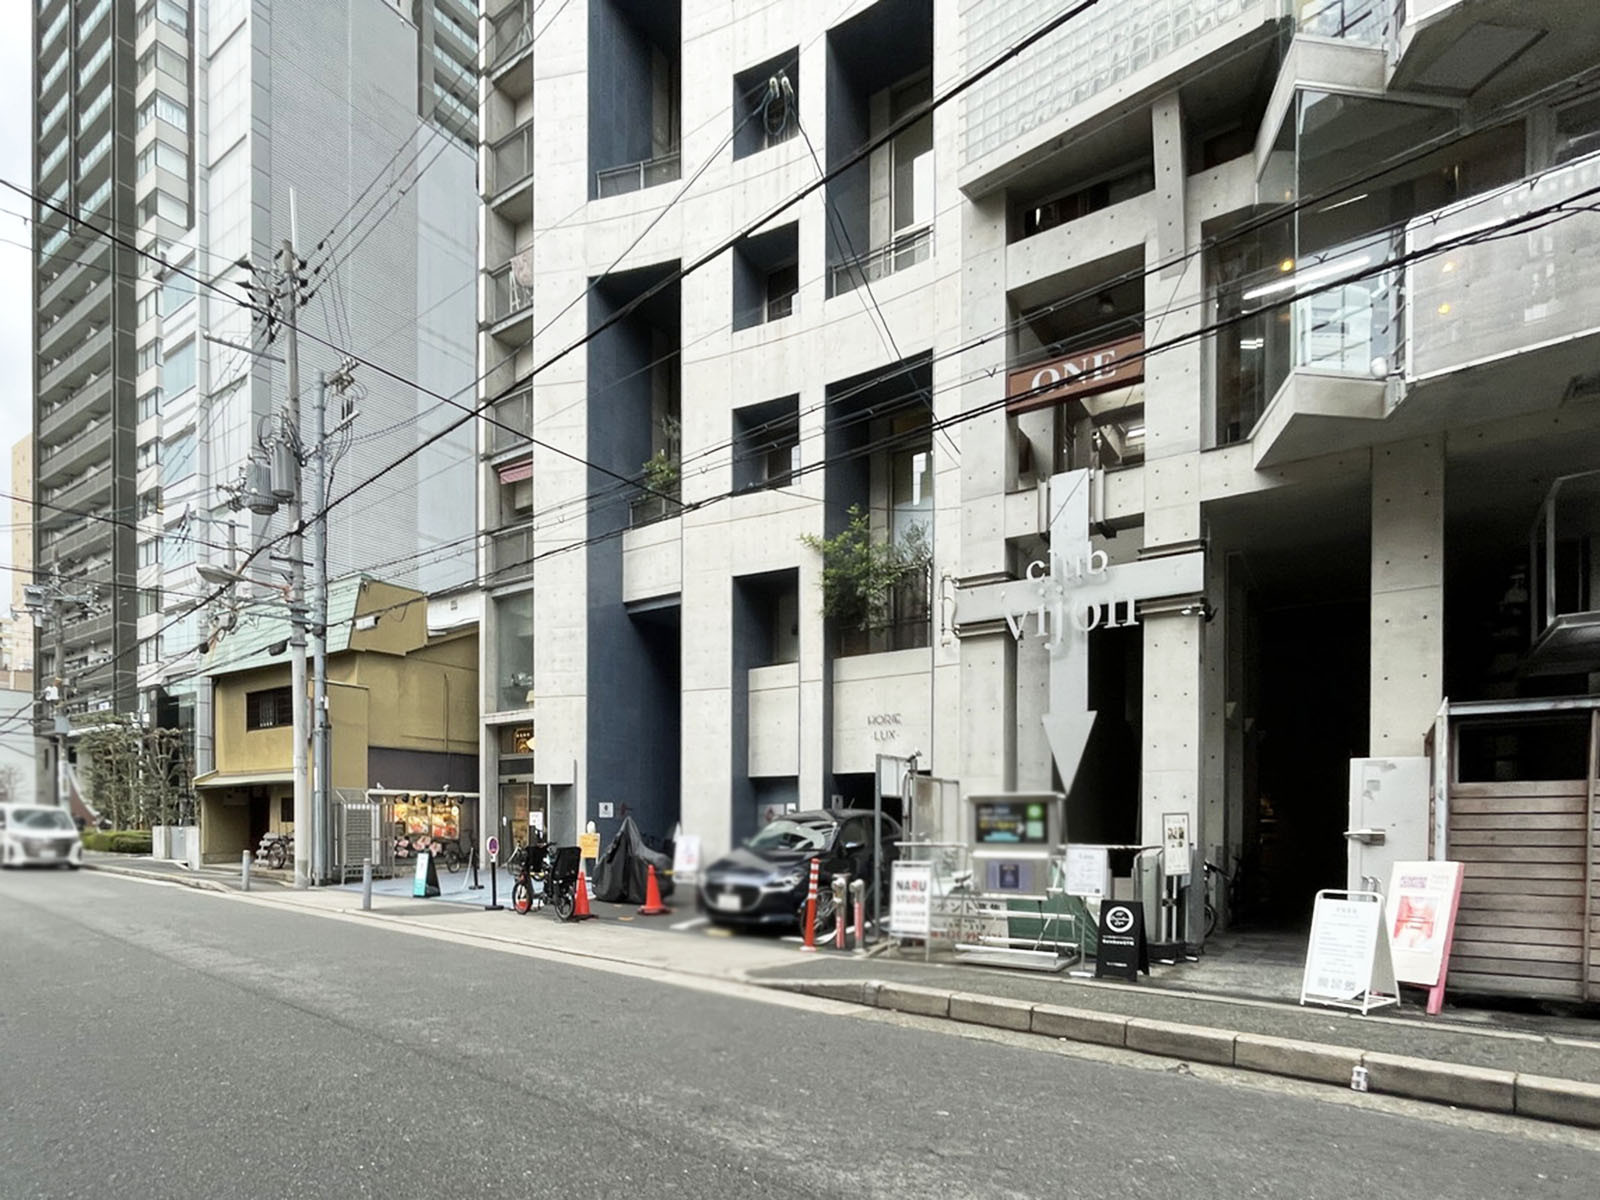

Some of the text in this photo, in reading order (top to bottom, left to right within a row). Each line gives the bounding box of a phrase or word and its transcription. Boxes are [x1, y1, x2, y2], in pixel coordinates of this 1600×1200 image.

[1031, 350, 1116, 393] ONE
[874, 729, 896, 741] LUX
[896, 880, 927, 892] NARU
